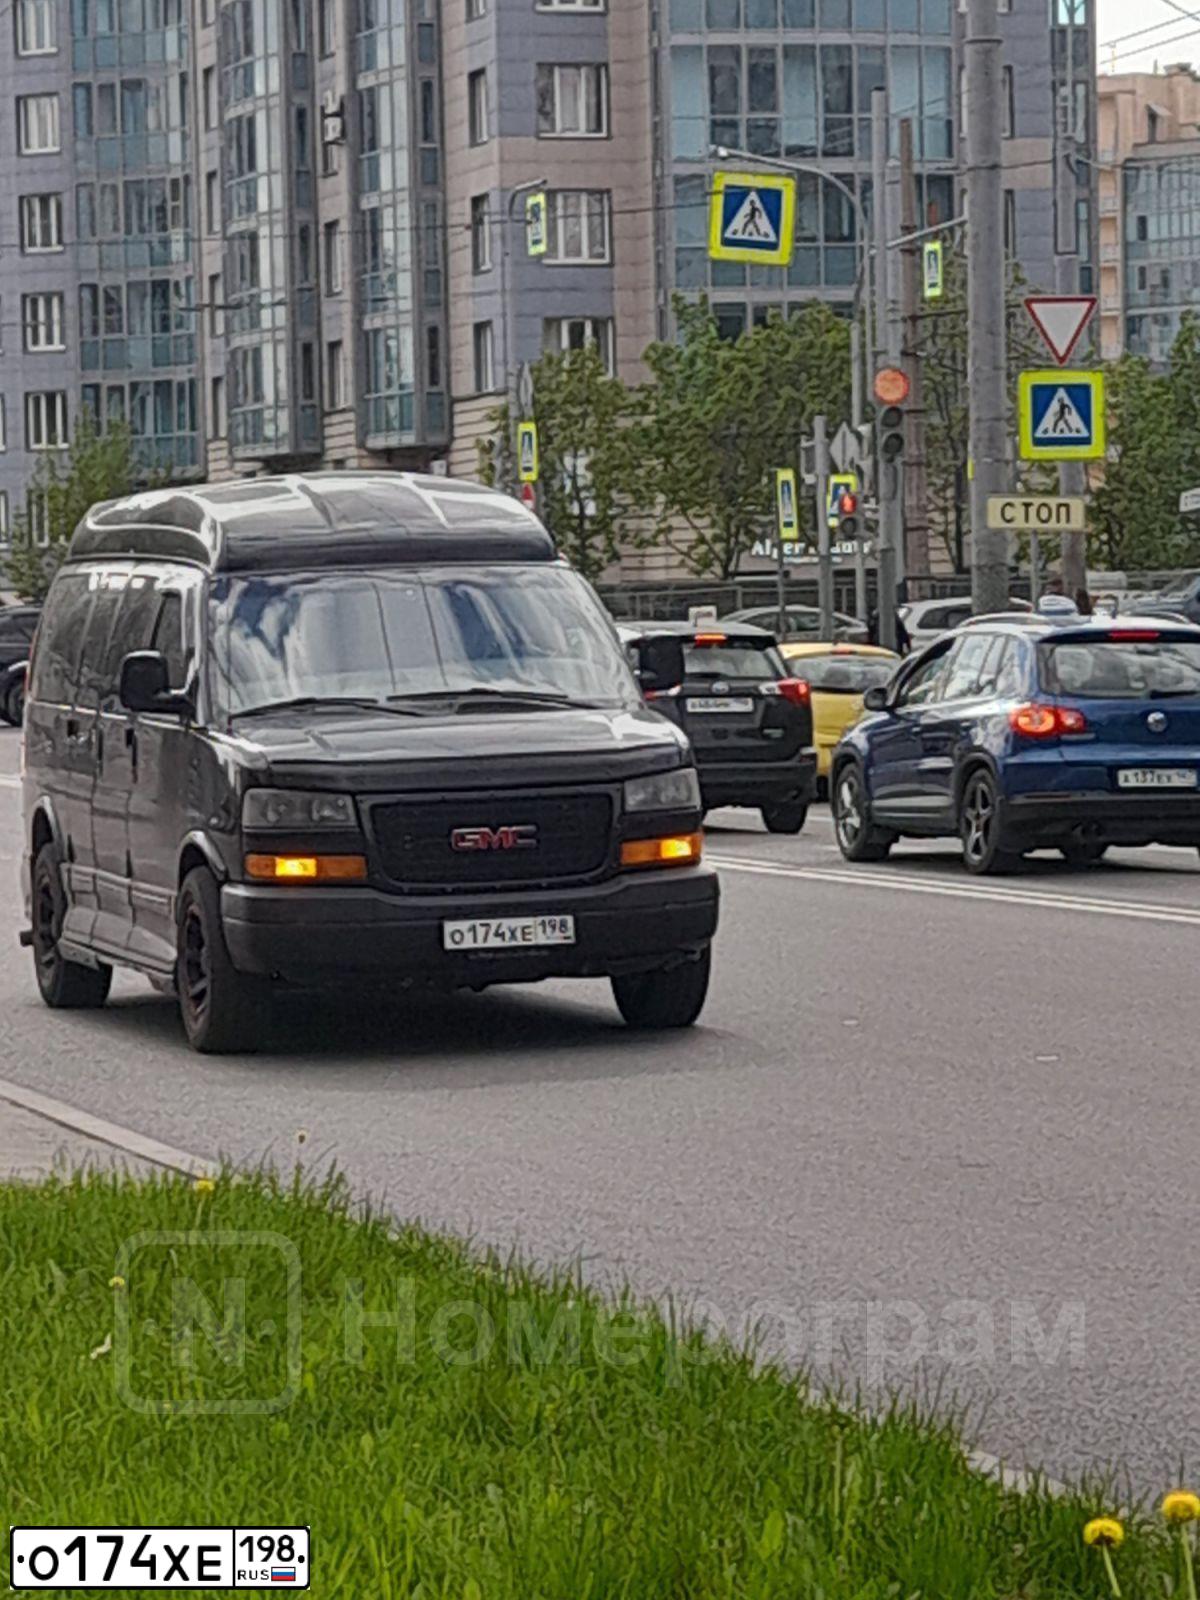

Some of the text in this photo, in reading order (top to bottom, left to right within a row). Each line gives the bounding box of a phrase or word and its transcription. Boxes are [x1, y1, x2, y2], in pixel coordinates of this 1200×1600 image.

[1000, 502, 1071, 524] СТОП
[451, 824, 537, 851] GMC
[450, 918, 569, 945] О174ХЕ 198
